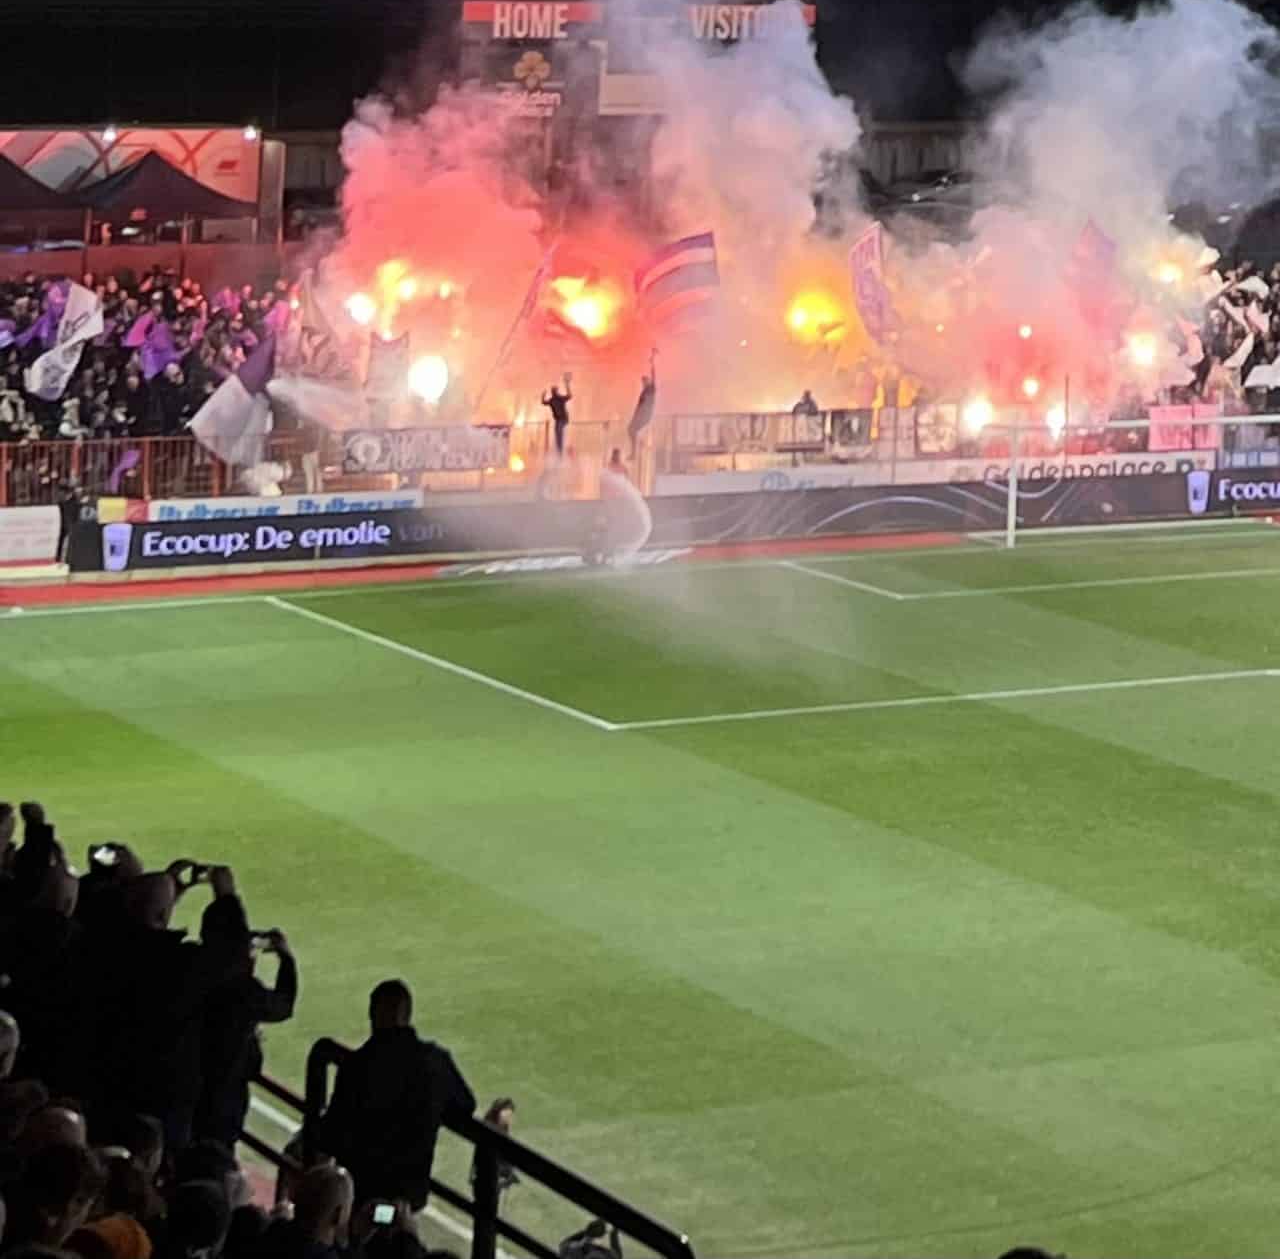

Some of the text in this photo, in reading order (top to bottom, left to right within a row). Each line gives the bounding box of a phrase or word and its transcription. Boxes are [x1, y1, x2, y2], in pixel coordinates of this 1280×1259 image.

[493, 2, 768, 40] HOME VISIT
[142, 530, 251, 558] Ecocup:
[255, 525, 294, 551] De
